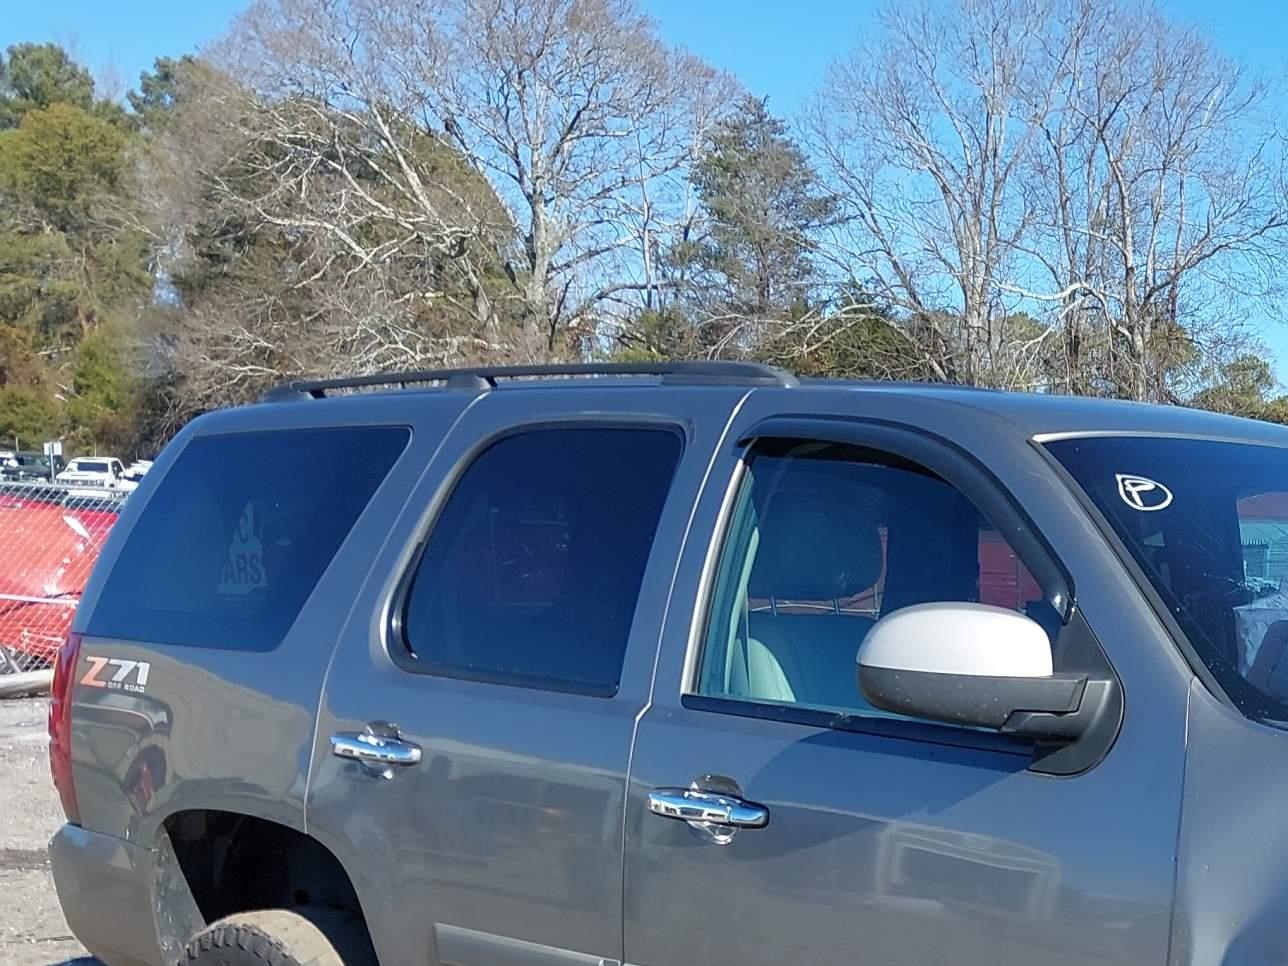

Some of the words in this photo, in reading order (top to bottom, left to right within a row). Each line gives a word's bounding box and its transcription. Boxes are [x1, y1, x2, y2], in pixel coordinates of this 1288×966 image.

[80, 655, 150, 687] Z71
[107, 681, 122, 689] OFF
[124, 683, 145, 693] ROAD
